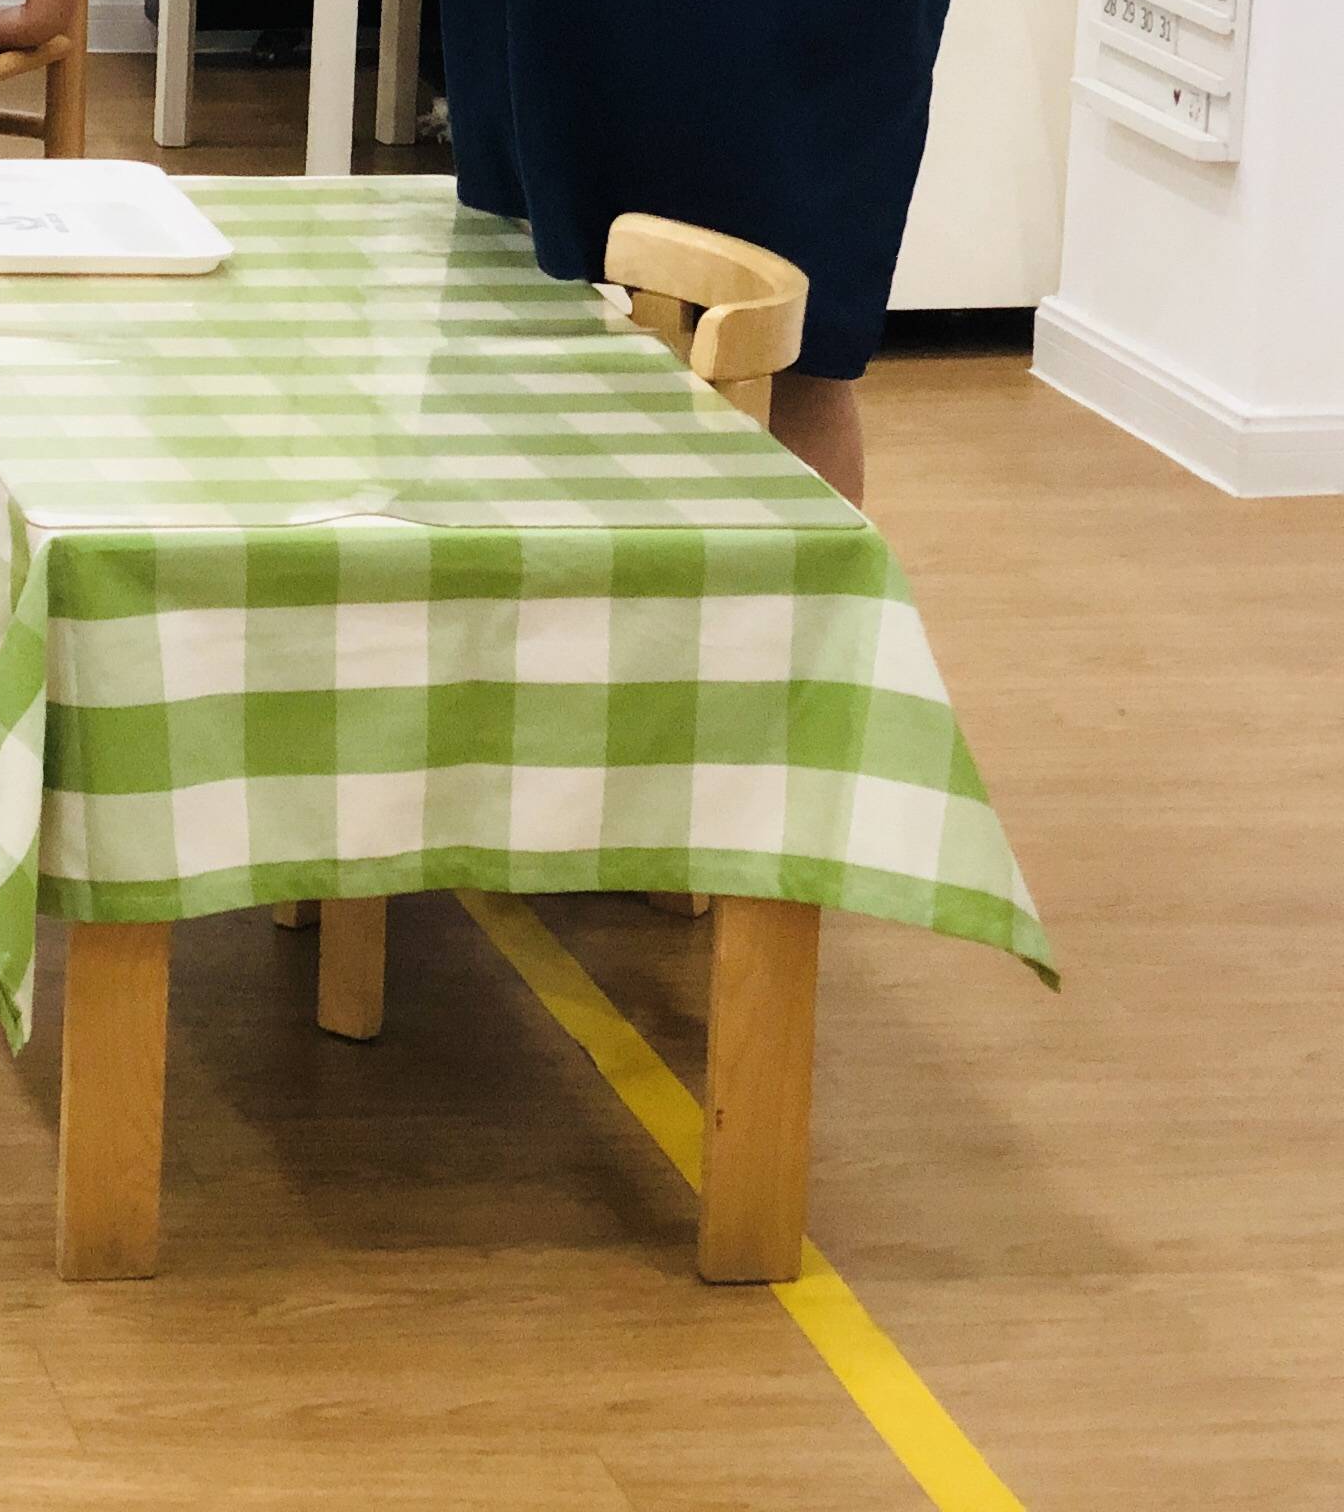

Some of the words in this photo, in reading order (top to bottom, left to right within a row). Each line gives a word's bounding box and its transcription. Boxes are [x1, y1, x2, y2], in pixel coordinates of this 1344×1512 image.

[1123, 0, 1135, 23] 29
[1140, 7, 1153, 32] 30
[1160, 16, 1171, 41] 31
